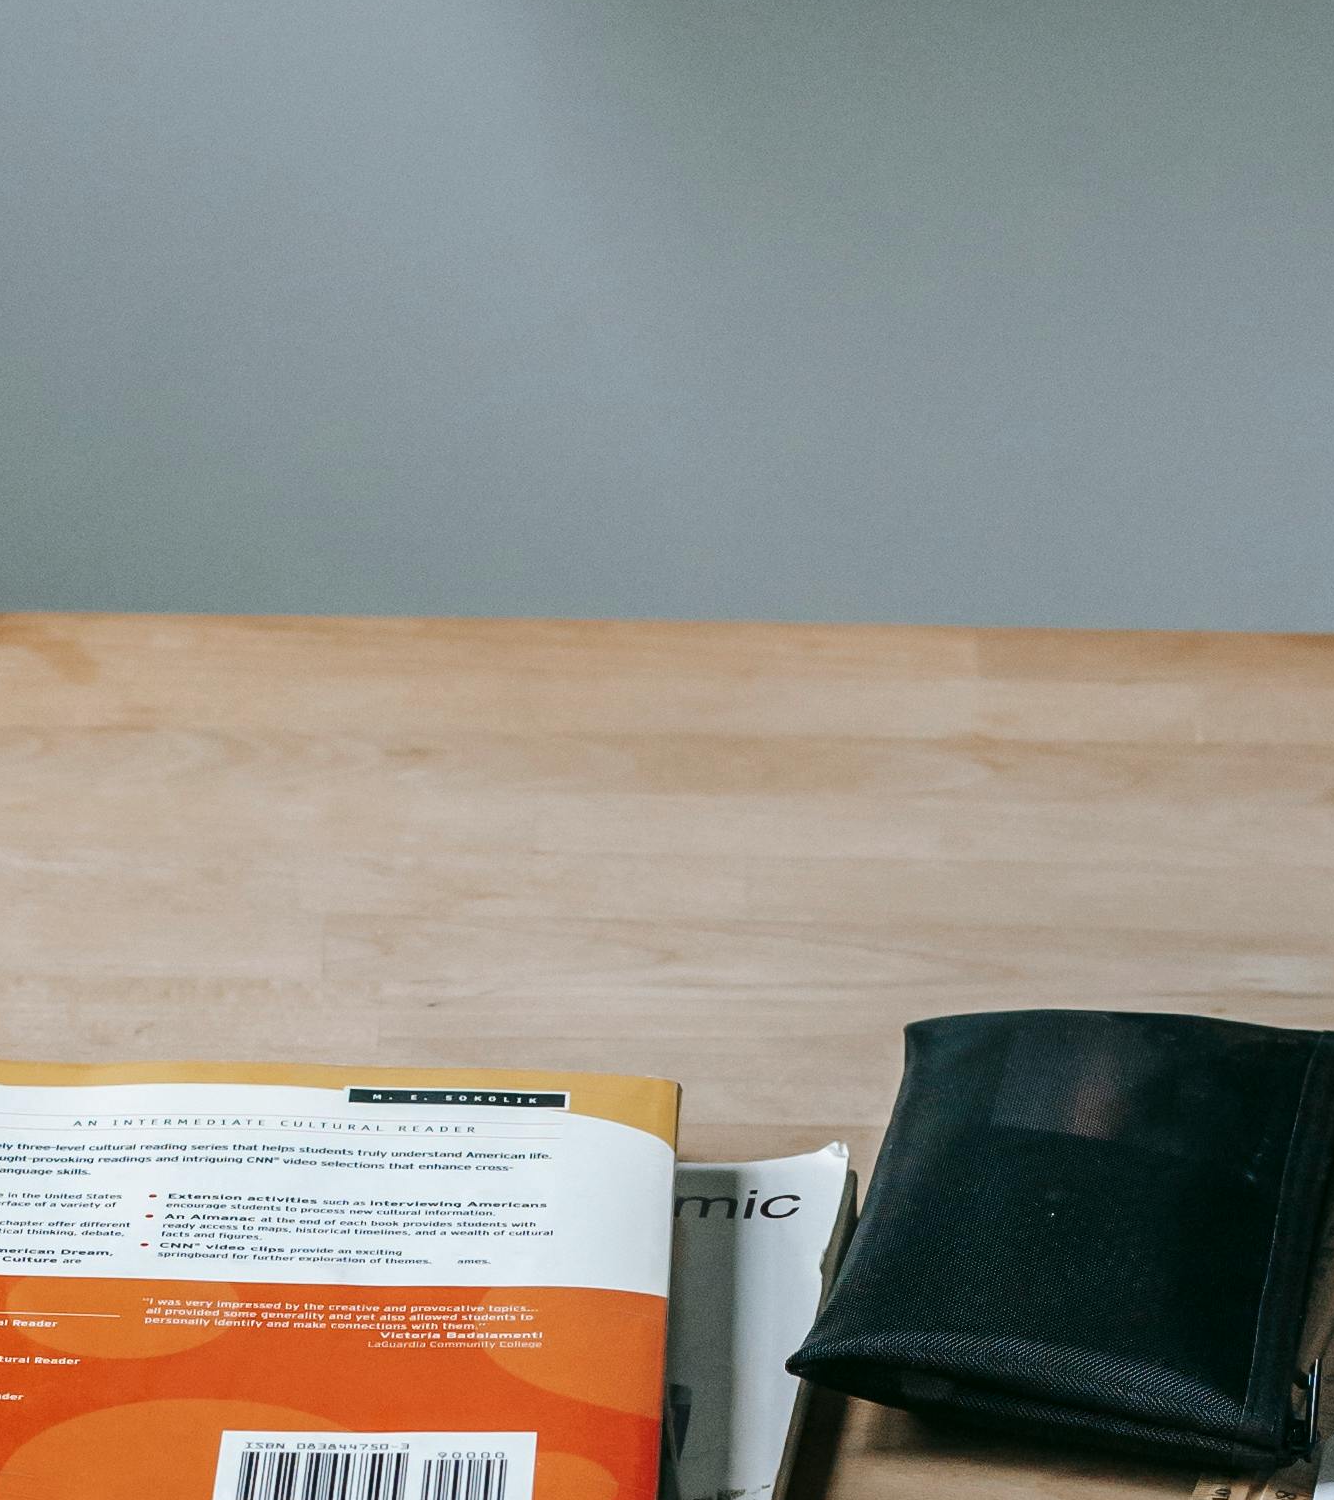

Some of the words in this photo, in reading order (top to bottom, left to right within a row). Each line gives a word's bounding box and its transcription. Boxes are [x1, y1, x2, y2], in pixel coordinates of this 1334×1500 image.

[445, 1094, 538, 1104] SOKOLIK
[73, 1118, 98, 1127] AN
[113, 1117, 266, 1127] INTERMEDIATE
[280, 1119, 384, 1132] CULTURAL
[398, 1124, 476, 1133] READER
[17, 1143, 85, 1151] three-level
[140, 1143, 187, 1151] reading
[261, 1144, 295, 1153] helps
[299, 1146, 353, 1155] students
[357, 1149, 387, 1158] truly
[391, 1150, 462, 1158] understand
[466, 1151, 525, 1159] American
[182, 1155, 243, 1164] intriguing
[321, 1160, 385, 1169] selections
[389, 1162, 413, 1170] that
[12, 1319, 58, 1327] Reader
[380, 1331, 441, 1339] Victoria
[446, 1331, 543, 1339] Badalamenti
[367, 1340, 426, 1348] LaGuardia
[429, 1340, 496, 1349] Community
[499, 1340, 542, 1348] College
[34, 1356, 80, 1365] Reader
[245, 1441, 285, 1450] ISBN
[438, 1451, 505, 1459] 90000
[1275, 1490, 1297, 1500] 8
